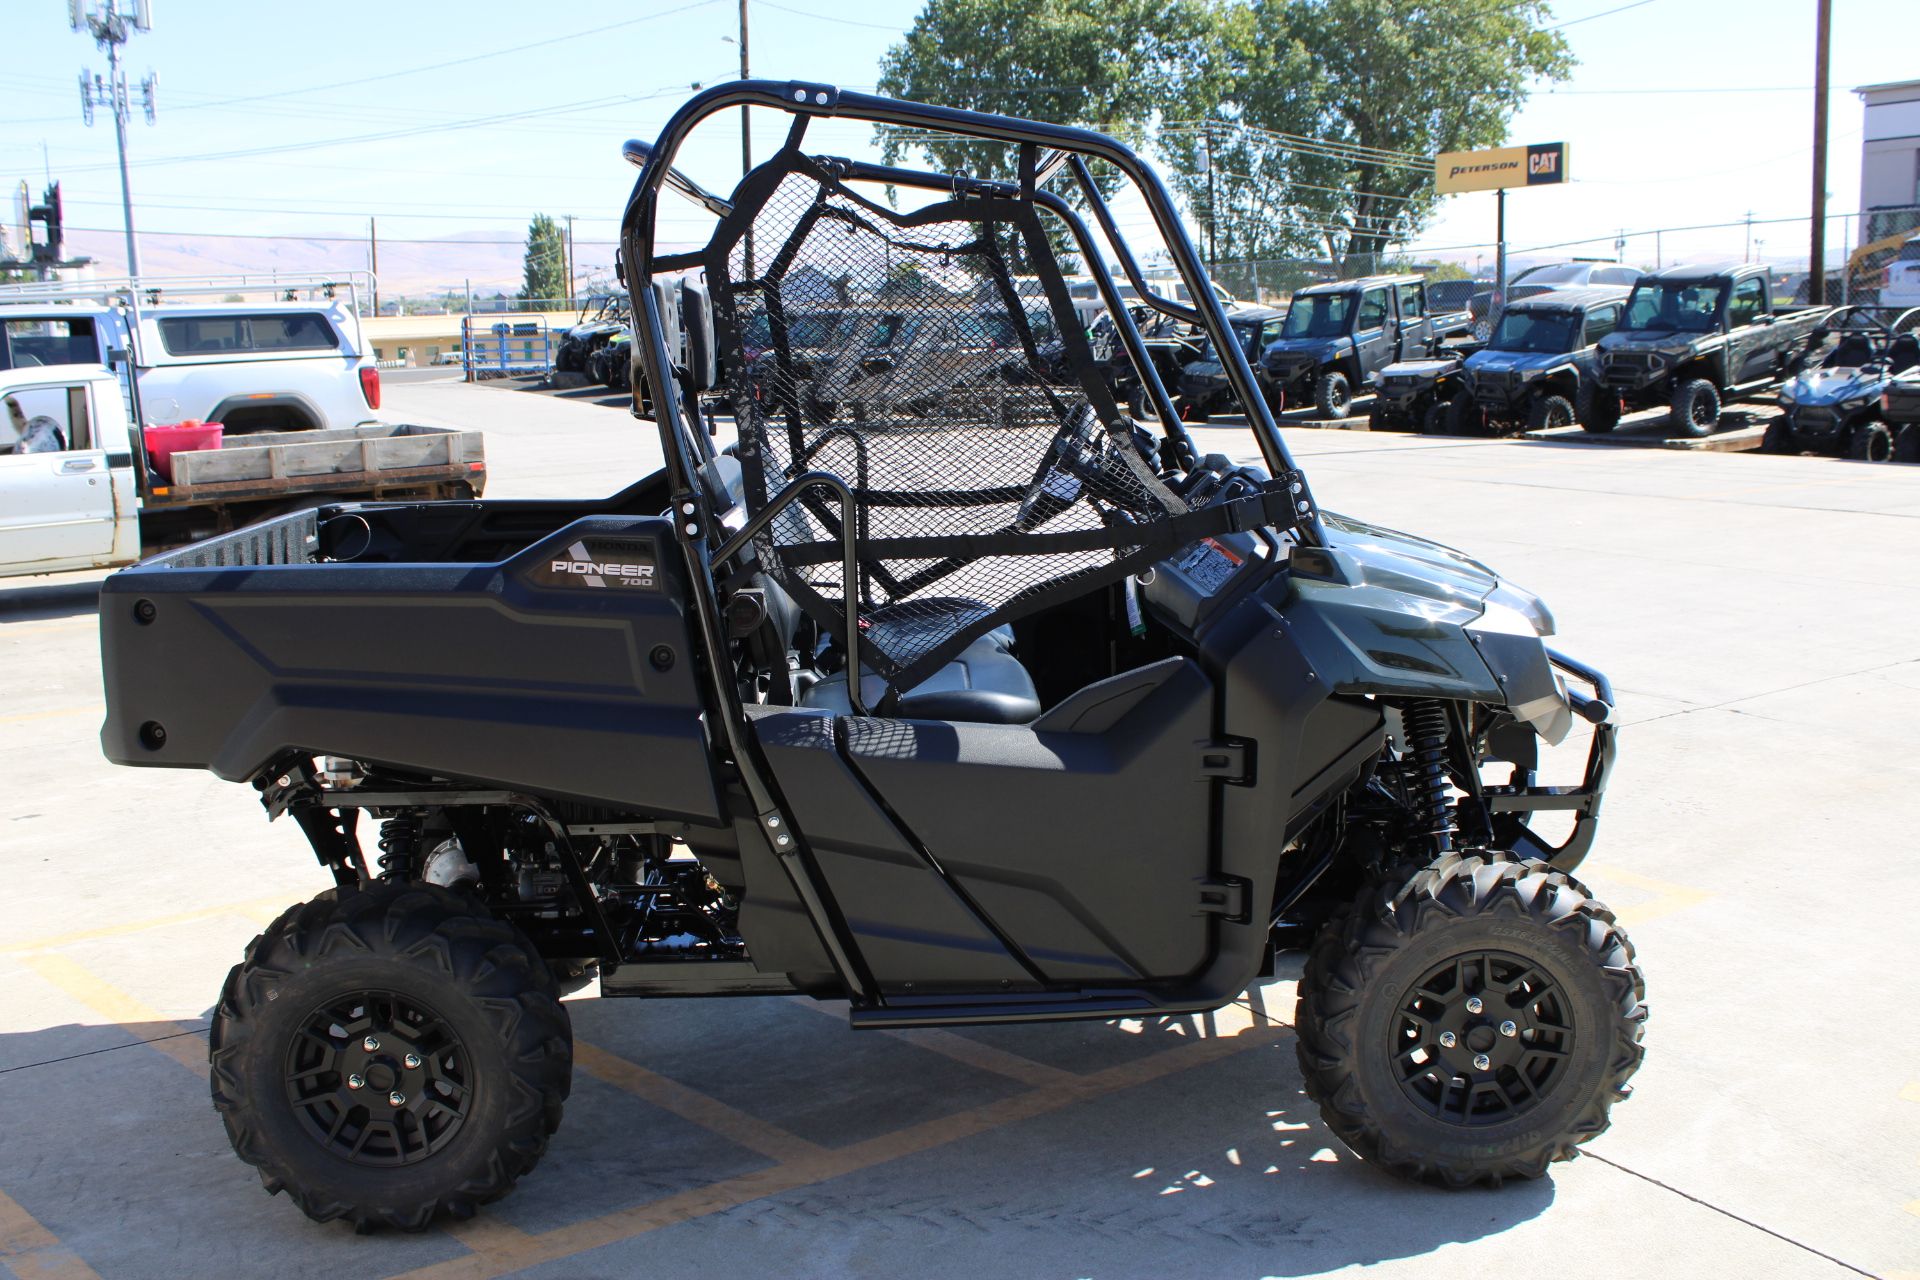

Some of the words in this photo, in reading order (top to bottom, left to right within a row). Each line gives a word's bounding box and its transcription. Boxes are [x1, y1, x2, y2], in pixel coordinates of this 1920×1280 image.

[1450, 162, 1519, 178] PETERSON
[1530, 152, 1558, 174] CAT
[591, 542, 649, 552] HONDA
[552, 561, 654, 577] PIONEER
[620, 578, 652, 586] 700
